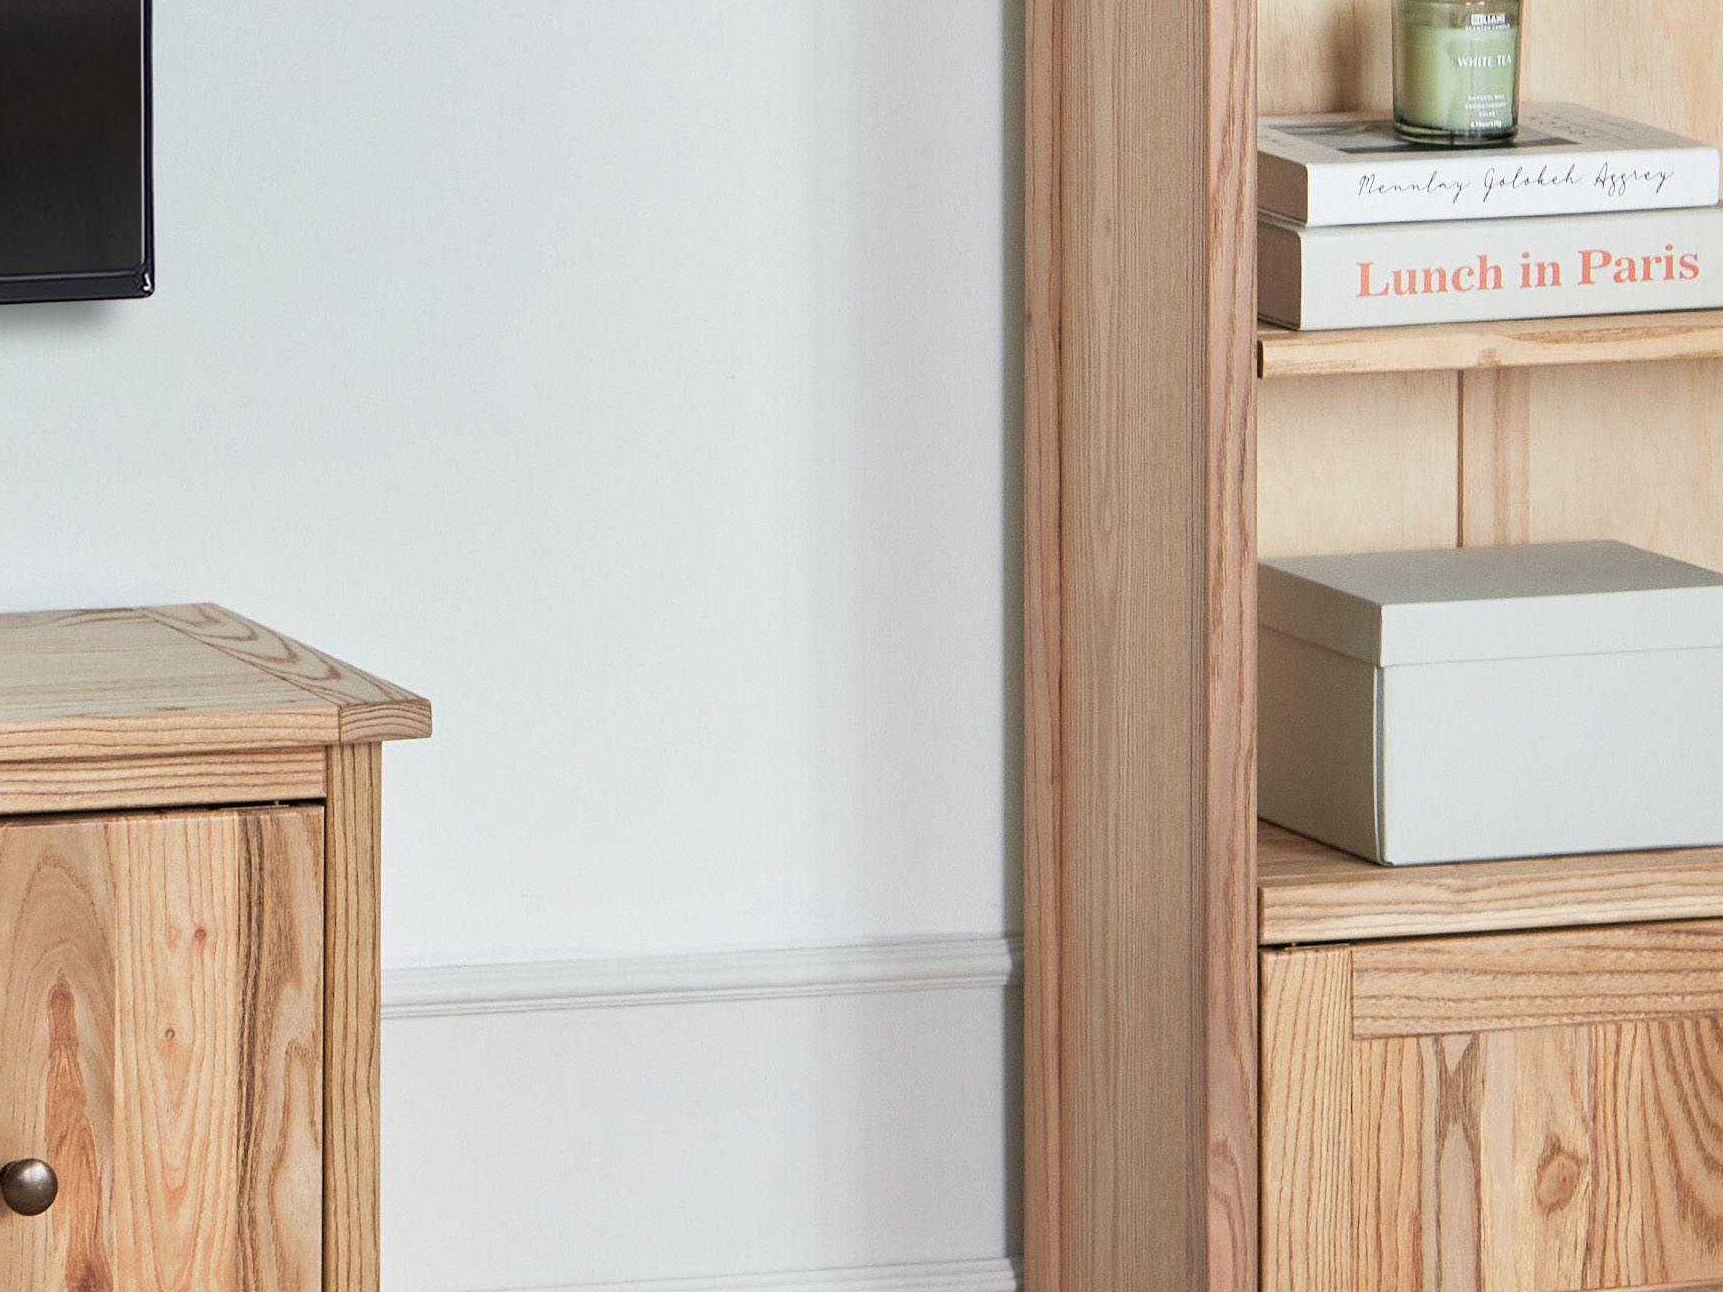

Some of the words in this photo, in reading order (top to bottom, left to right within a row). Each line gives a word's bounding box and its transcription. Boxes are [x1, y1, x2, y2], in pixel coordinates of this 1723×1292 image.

[1457, 55, 1492, 69] WHITE
[1355, 254, 1504, 298] Lunch
[1519, 251, 1563, 289] in
[1577, 243, 1700, 286] Paris
